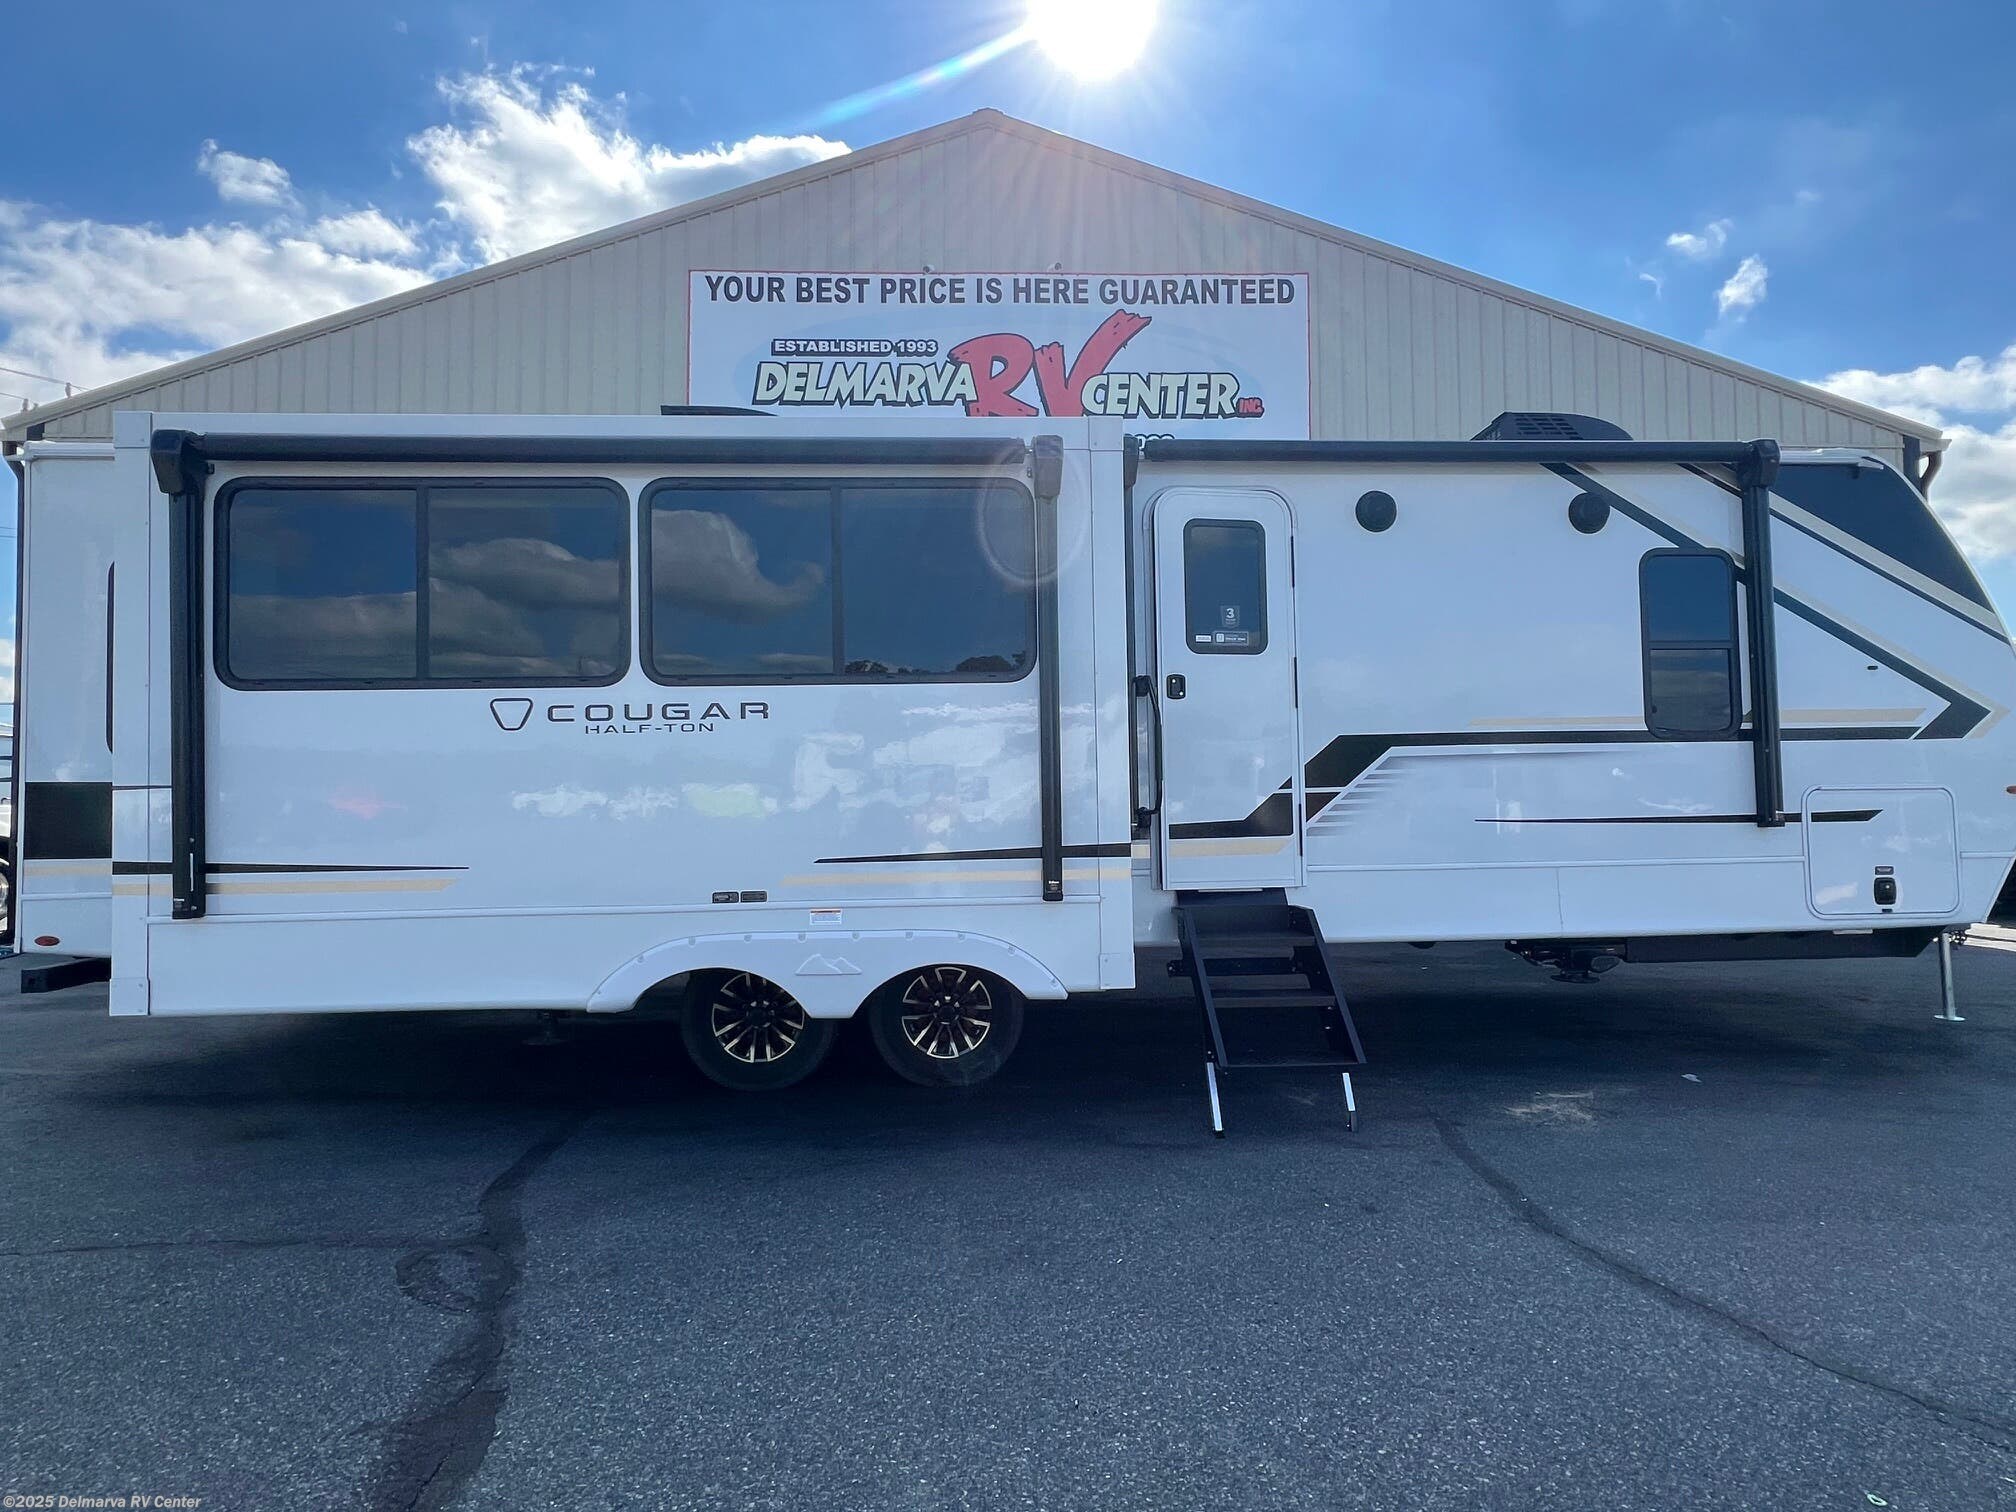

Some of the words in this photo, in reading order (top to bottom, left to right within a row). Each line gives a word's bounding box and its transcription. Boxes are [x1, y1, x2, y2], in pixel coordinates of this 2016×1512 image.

[705, 275, 786, 302] YOUR
[796, 277, 870, 304] BEST
[880, 278, 966, 304] PRICE
[976, 278, 1002, 304] IS
[1013, 278, 1089, 304] HERE
[1100, 278, 1295, 305] GUARANTEED
[773, 340, 893, 353] ESTABLISHED
[897, 340, 938, 353] 1993
[753, 361, 979, 407] DELMARVA
[946, 309, 1152, 417] RV
[1080, 371, 1239, 419] CENTER
[1226, 608, 1235, 619] 3
[547, 702, 769, 722] COUGAR
[585, 722, 714, 734] HALF-TON
